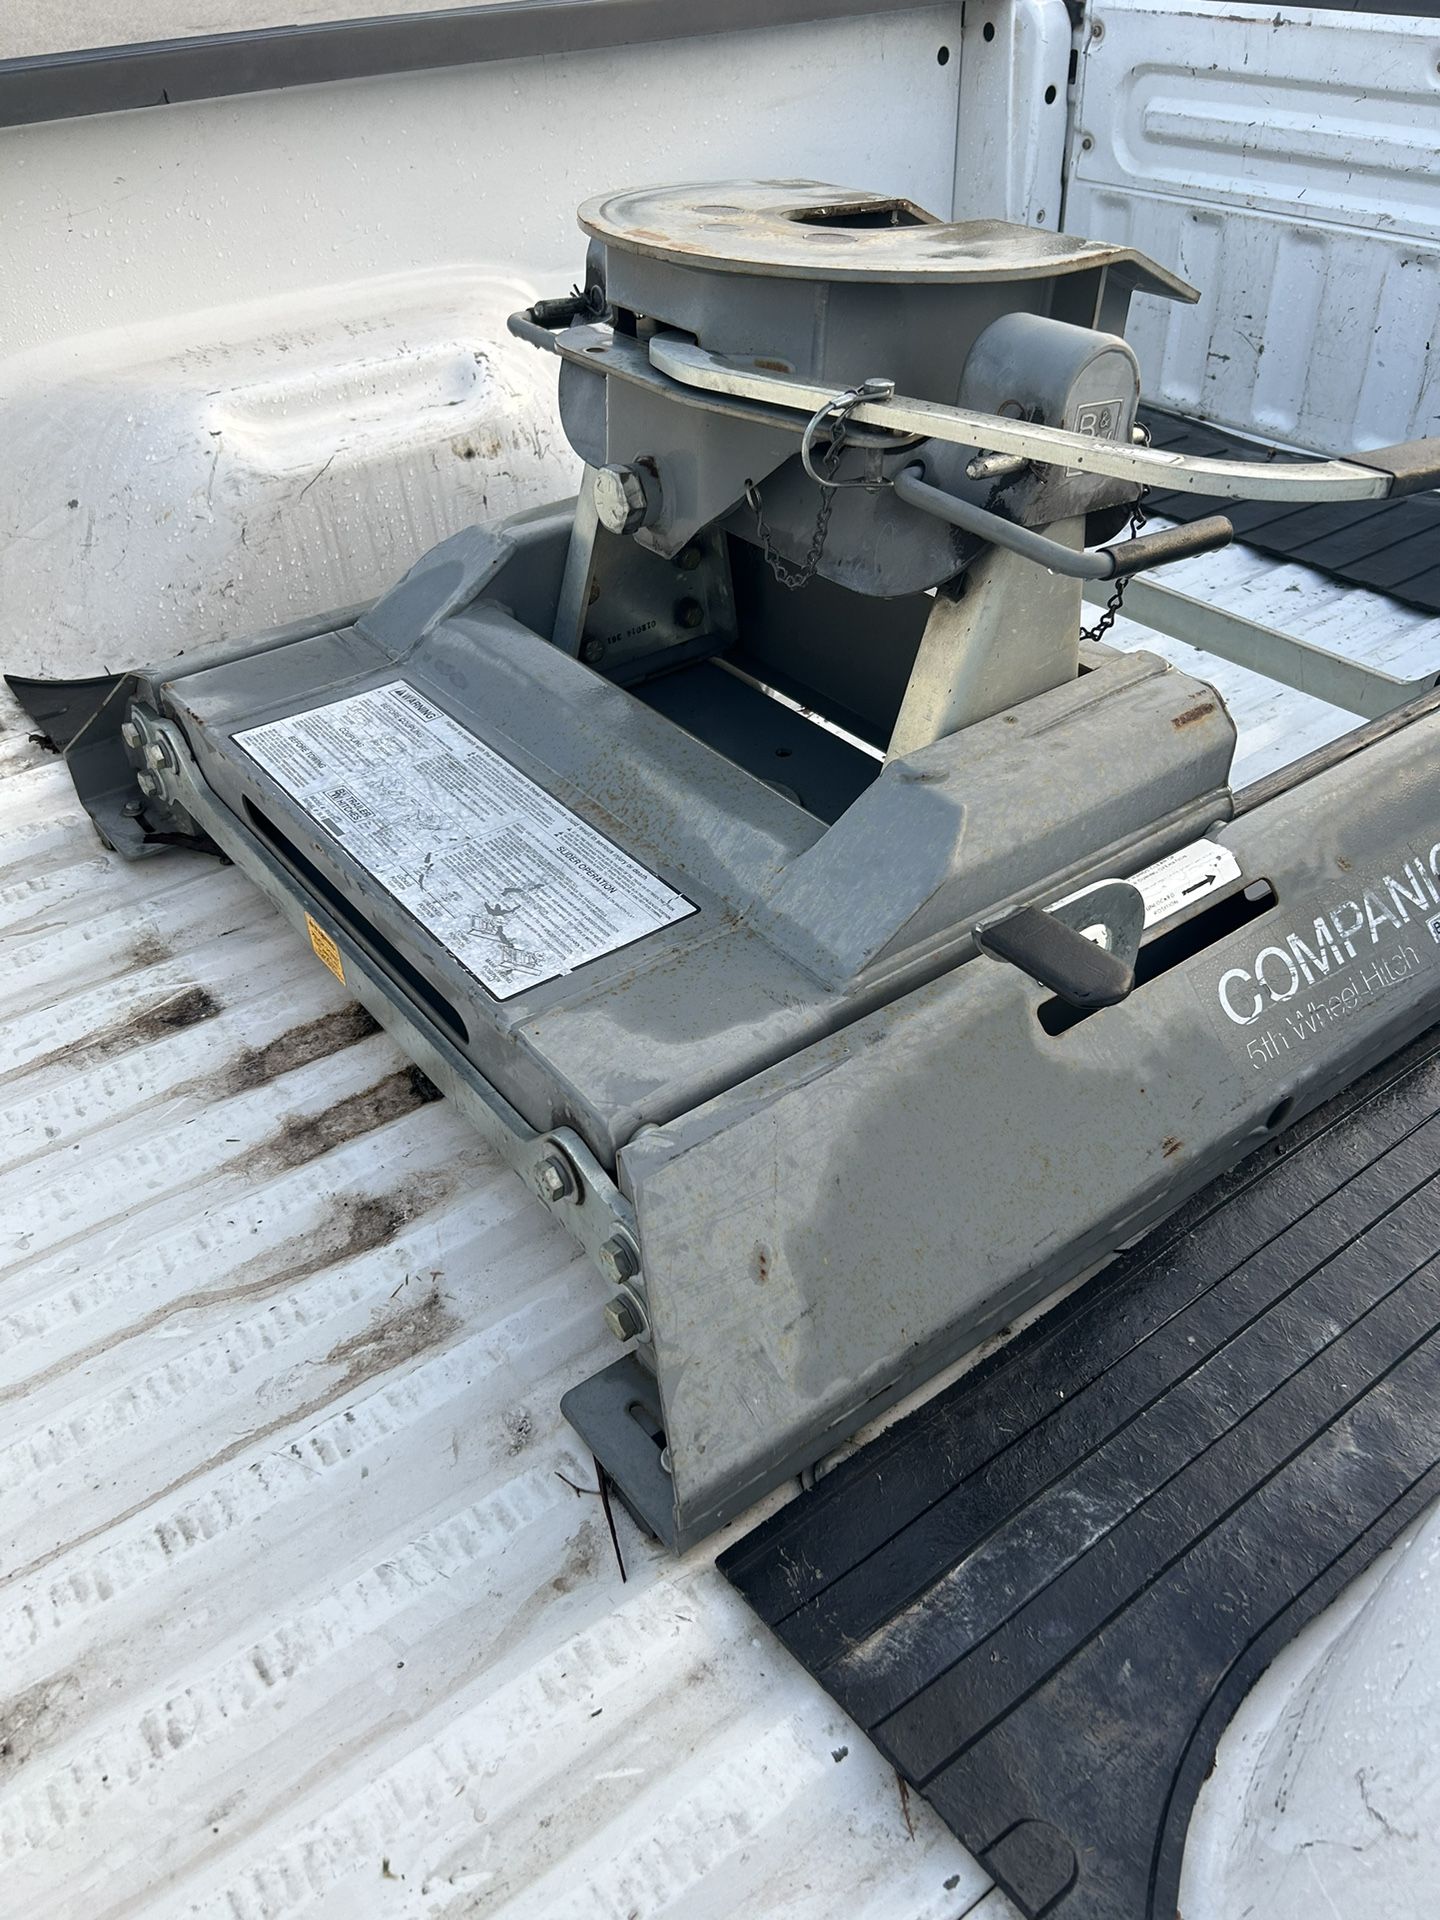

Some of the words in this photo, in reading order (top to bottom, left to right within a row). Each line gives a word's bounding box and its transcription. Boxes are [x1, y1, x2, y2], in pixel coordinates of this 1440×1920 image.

[401, 691, 437, 720] WARNING
[555, 845, 582, 865] SLIDER
[576, 863, 617, 893] OPERATION
[1218, 841, 1440, 1026] COMPANI
[1246, 1029, 1291, 1070] 5th
